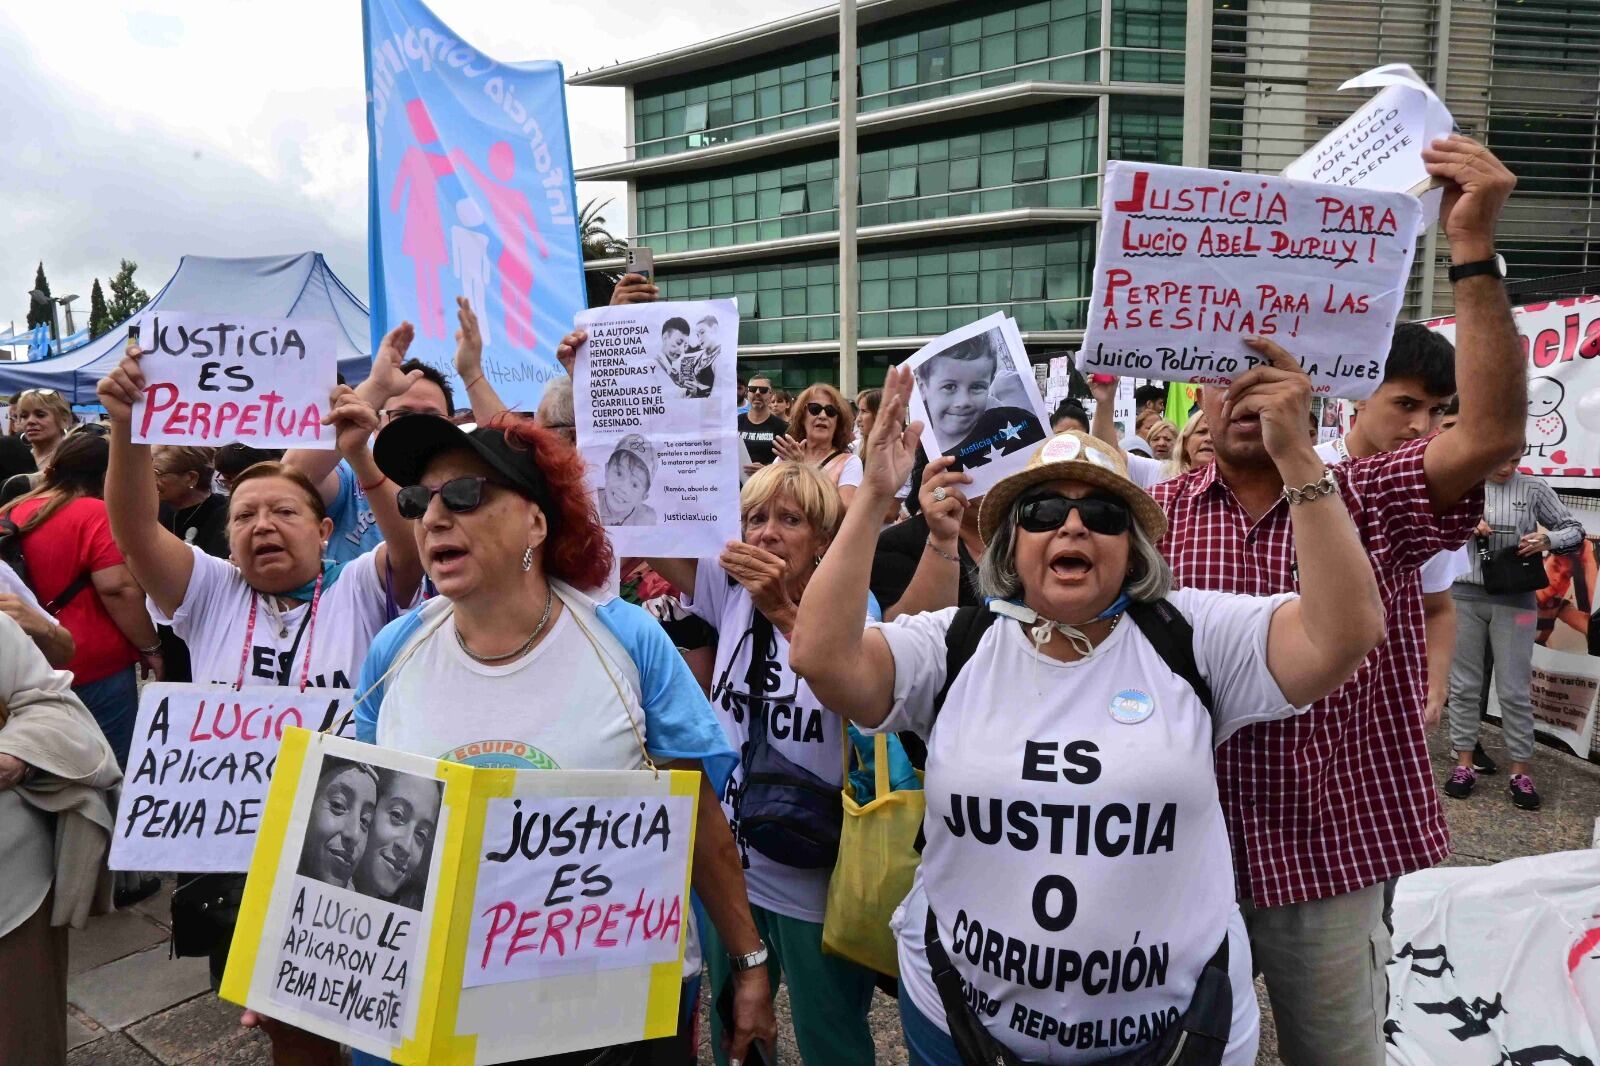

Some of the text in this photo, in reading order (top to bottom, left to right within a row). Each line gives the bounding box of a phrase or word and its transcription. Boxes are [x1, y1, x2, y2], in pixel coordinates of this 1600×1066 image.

[1312, 108, 1400, 180] POR LUCIO
[1315, 107, 1385, 163] JUSTICIA
[1324, 123, 1405, 184] LAYPOLE
[1343, 135, 1413, 187] ESENTE
[1316, 197, 1398, 232] PARA
[1197, 224, 1262, 255] ABEL
[1103, 269, 1370, 314] PERPETUA PARA LAS
[590, 336, 642, 348] DEVELÓ UNA
[593, 326, 649, 337] LA AUTOPSIA
[590, 347, 647, 358] HEMORRAGIA
[591, 358, 628, 368] INTERNA,
[198, 361, 254, 392] ES
[590, 378, 618, 388] HASTA
[591, 366, 657, 378] MORDEDURAS Y
[591, 386, 662, 398] QUEMADURAS DE
[592, 396, 665, 408] CIGARRILLO EN EL
[139, 382, 321, 440] PERPETUA
[592, 404, 666, 418] CUERPO DEL NIÑO
[592, 418, 643, 428] ASESINADO.
[657, 450, 683, 458] genitales
[960, 438, 992, 457] Justicia
[147, 697, 170, 746] A
[454, 742, 527, 760] EQUIPO
[1021, 739, 1102, 785] ES
[124, 795, 261, 838] PENA DE
[943, 793, 1177, 858] JUSTICIA
[544, 864, 613, 907] ES
[1032, 874, 1078, 932] O
[292, 886, 306, 925] A
[377, 911, 411, 951] LE
[952, 909, 1169, 996] CORRUPCIÓN
[381, 956, 408, 989] LA
[277, 960, 401, 1030] PENA DE MUERTE
[1008, 1002, 1181, 1050] REPUBLICANO
